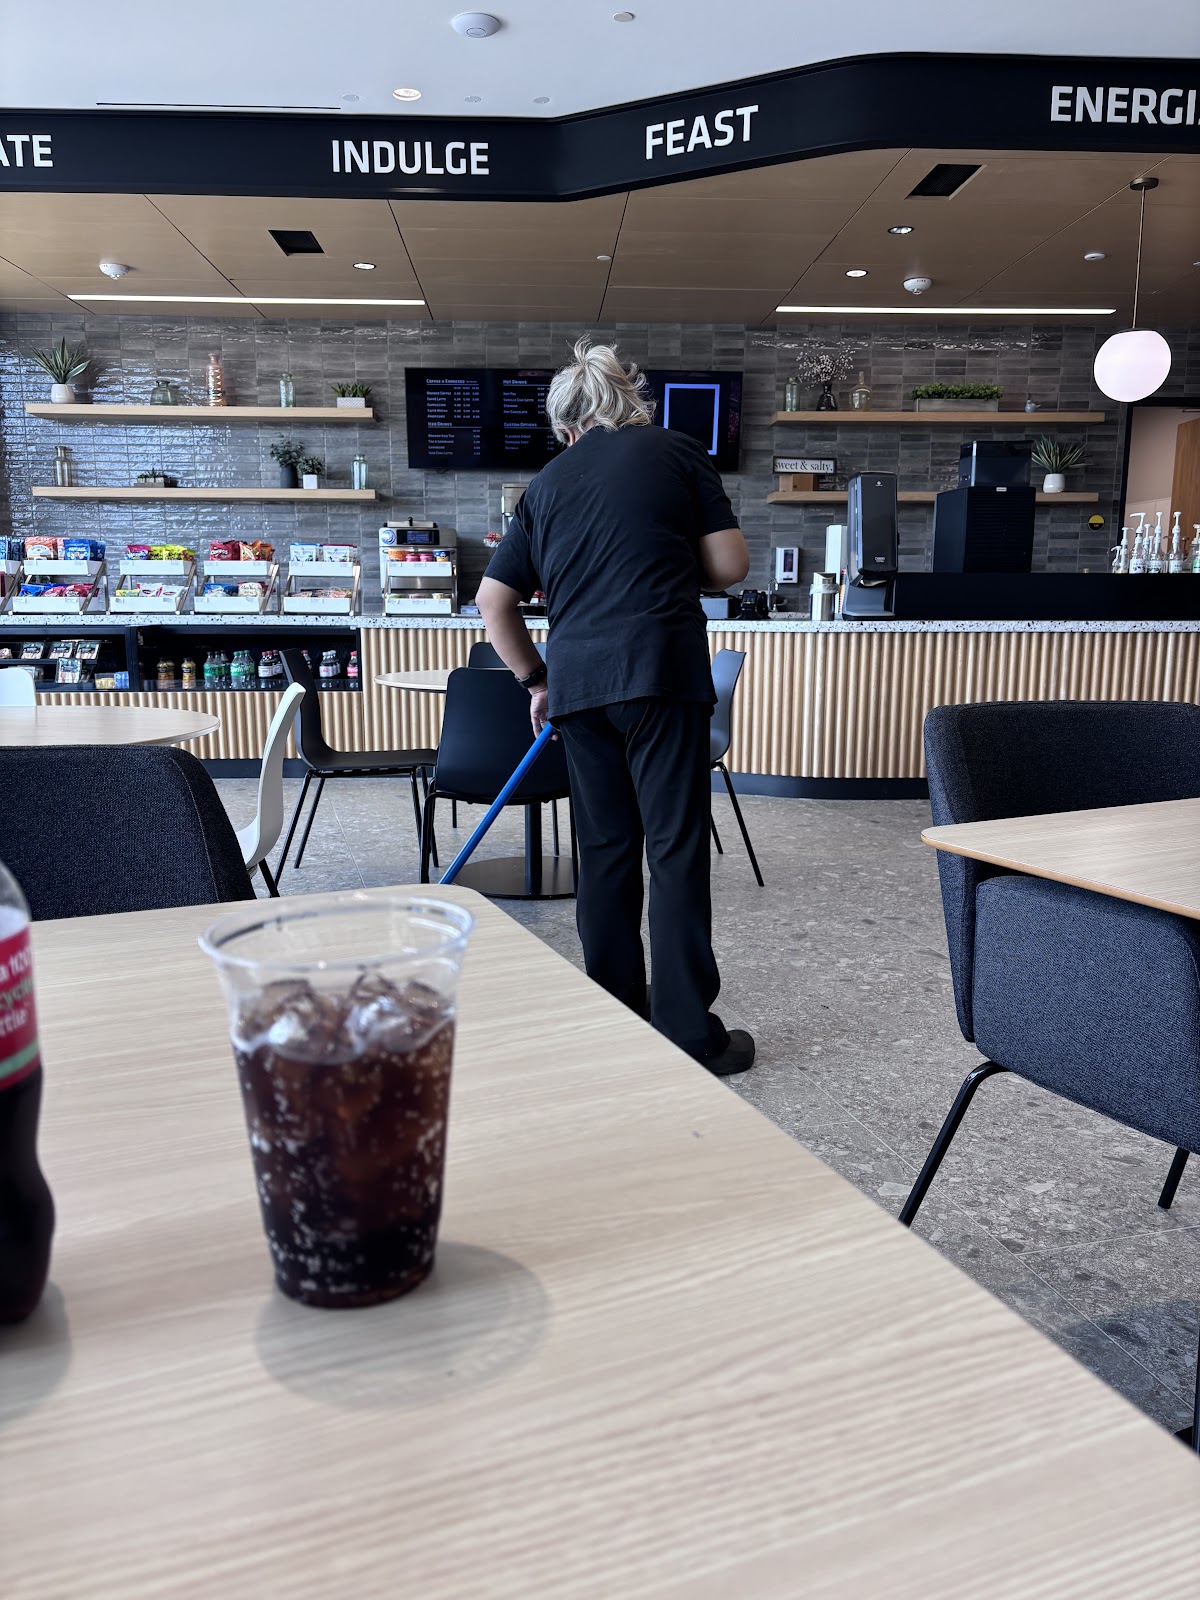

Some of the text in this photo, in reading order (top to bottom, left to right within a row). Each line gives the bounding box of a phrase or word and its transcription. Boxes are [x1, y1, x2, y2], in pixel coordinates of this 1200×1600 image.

[1051, 86, 1200, 125] ENERGI
[646, 105, 758, 160] FEAST
[333, 139, 489, 175] INDULGE
[774, 461, 798, 471] sweet
[800, 460, 808, 471] &
